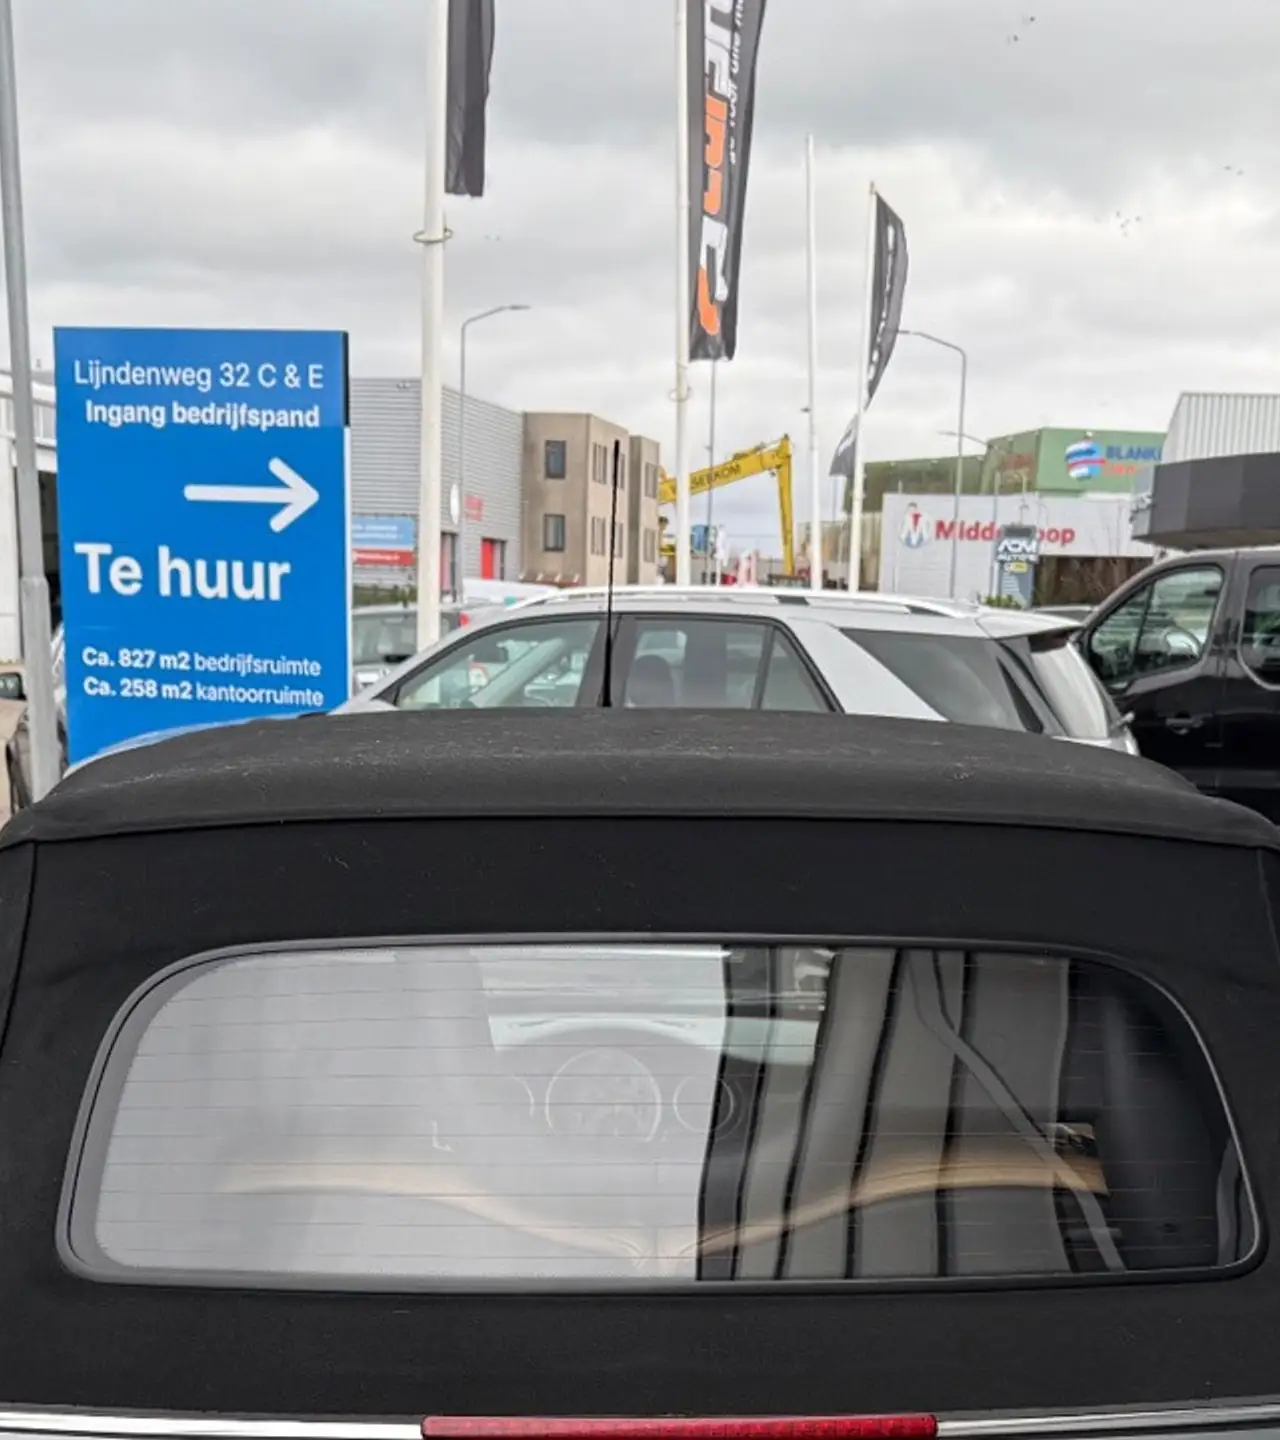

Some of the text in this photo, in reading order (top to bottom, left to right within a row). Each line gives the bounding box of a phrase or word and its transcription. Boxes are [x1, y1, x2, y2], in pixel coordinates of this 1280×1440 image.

[74, 360, 324, 391] Lijndenweg 32 C & E
[86, 400, 320, 431] Ingang bedrijfspand
[74, 543, 291, 601] Te huur
[82, 647, 322, 677] Ca. 827 m2 bedrijfsruimte
[83, 676, 324, 706] Ca. 258 m2 kantoorruimte
